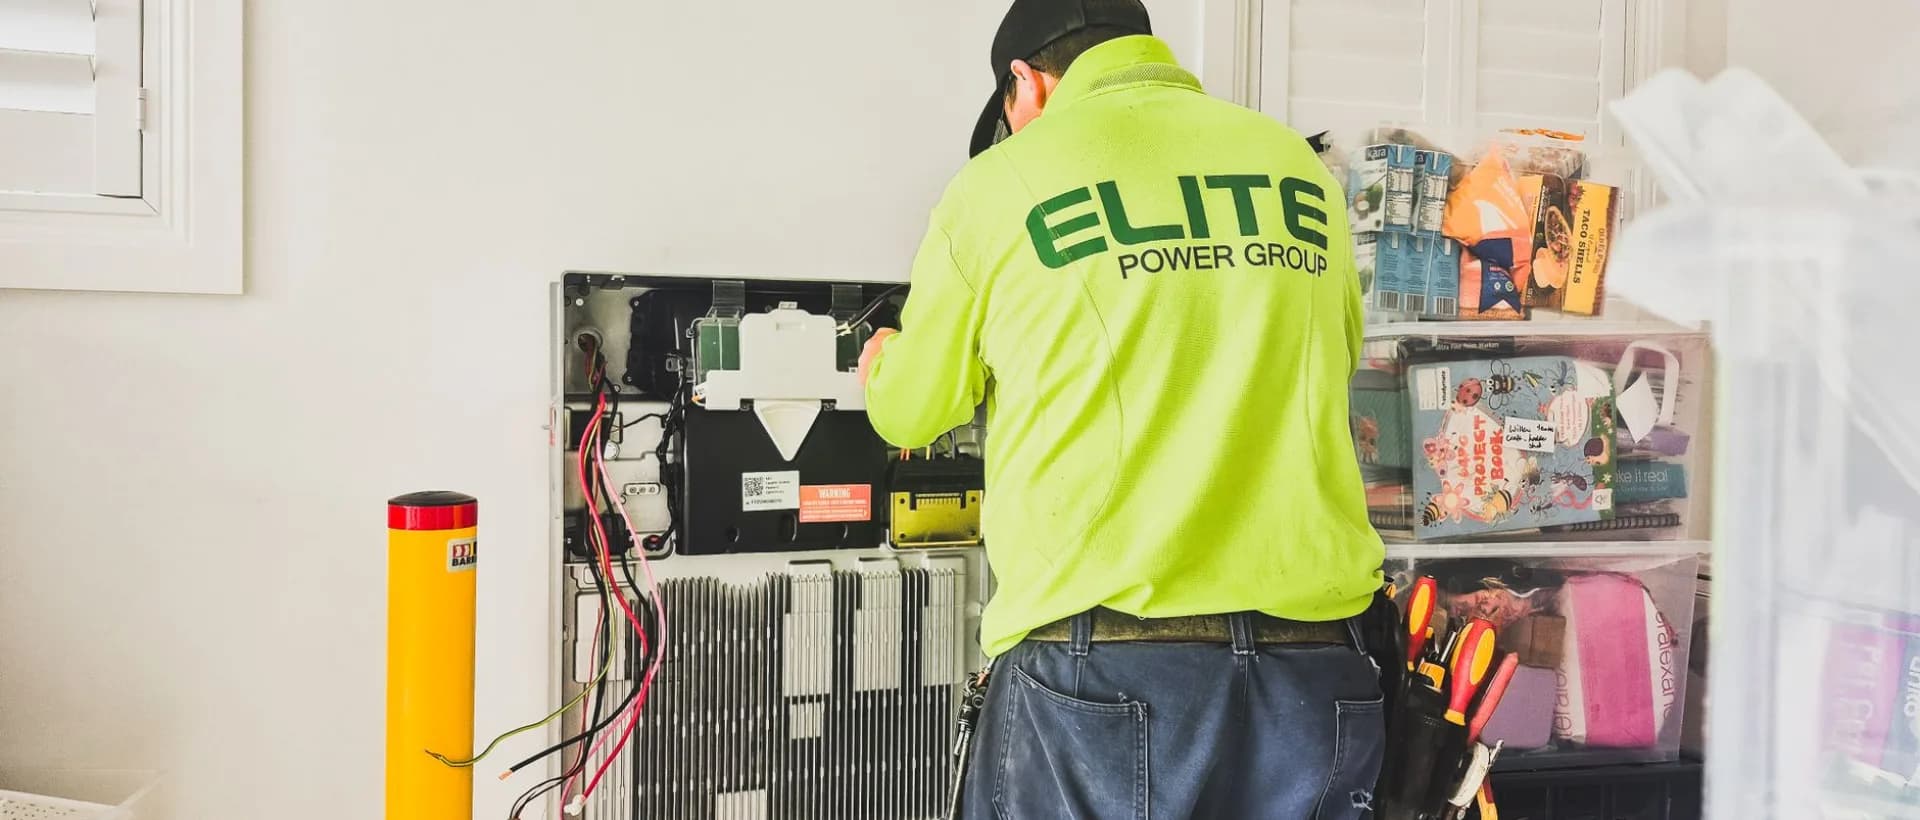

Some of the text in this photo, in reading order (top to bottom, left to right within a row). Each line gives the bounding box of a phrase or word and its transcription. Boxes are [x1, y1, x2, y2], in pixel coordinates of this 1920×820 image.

[1026, 174, 1328, 269] ELITE
[1580, 209, 1590, 238] TACO
[1118, 243, 1328, 279] POWER GROUP
[1573, 241, 1586, 283] SHELLS
[1474, 415, 1486, 495] PROJECT
[1490, 428, 1504, 479] BOOK
[1643, 469, 1668, 481] real
